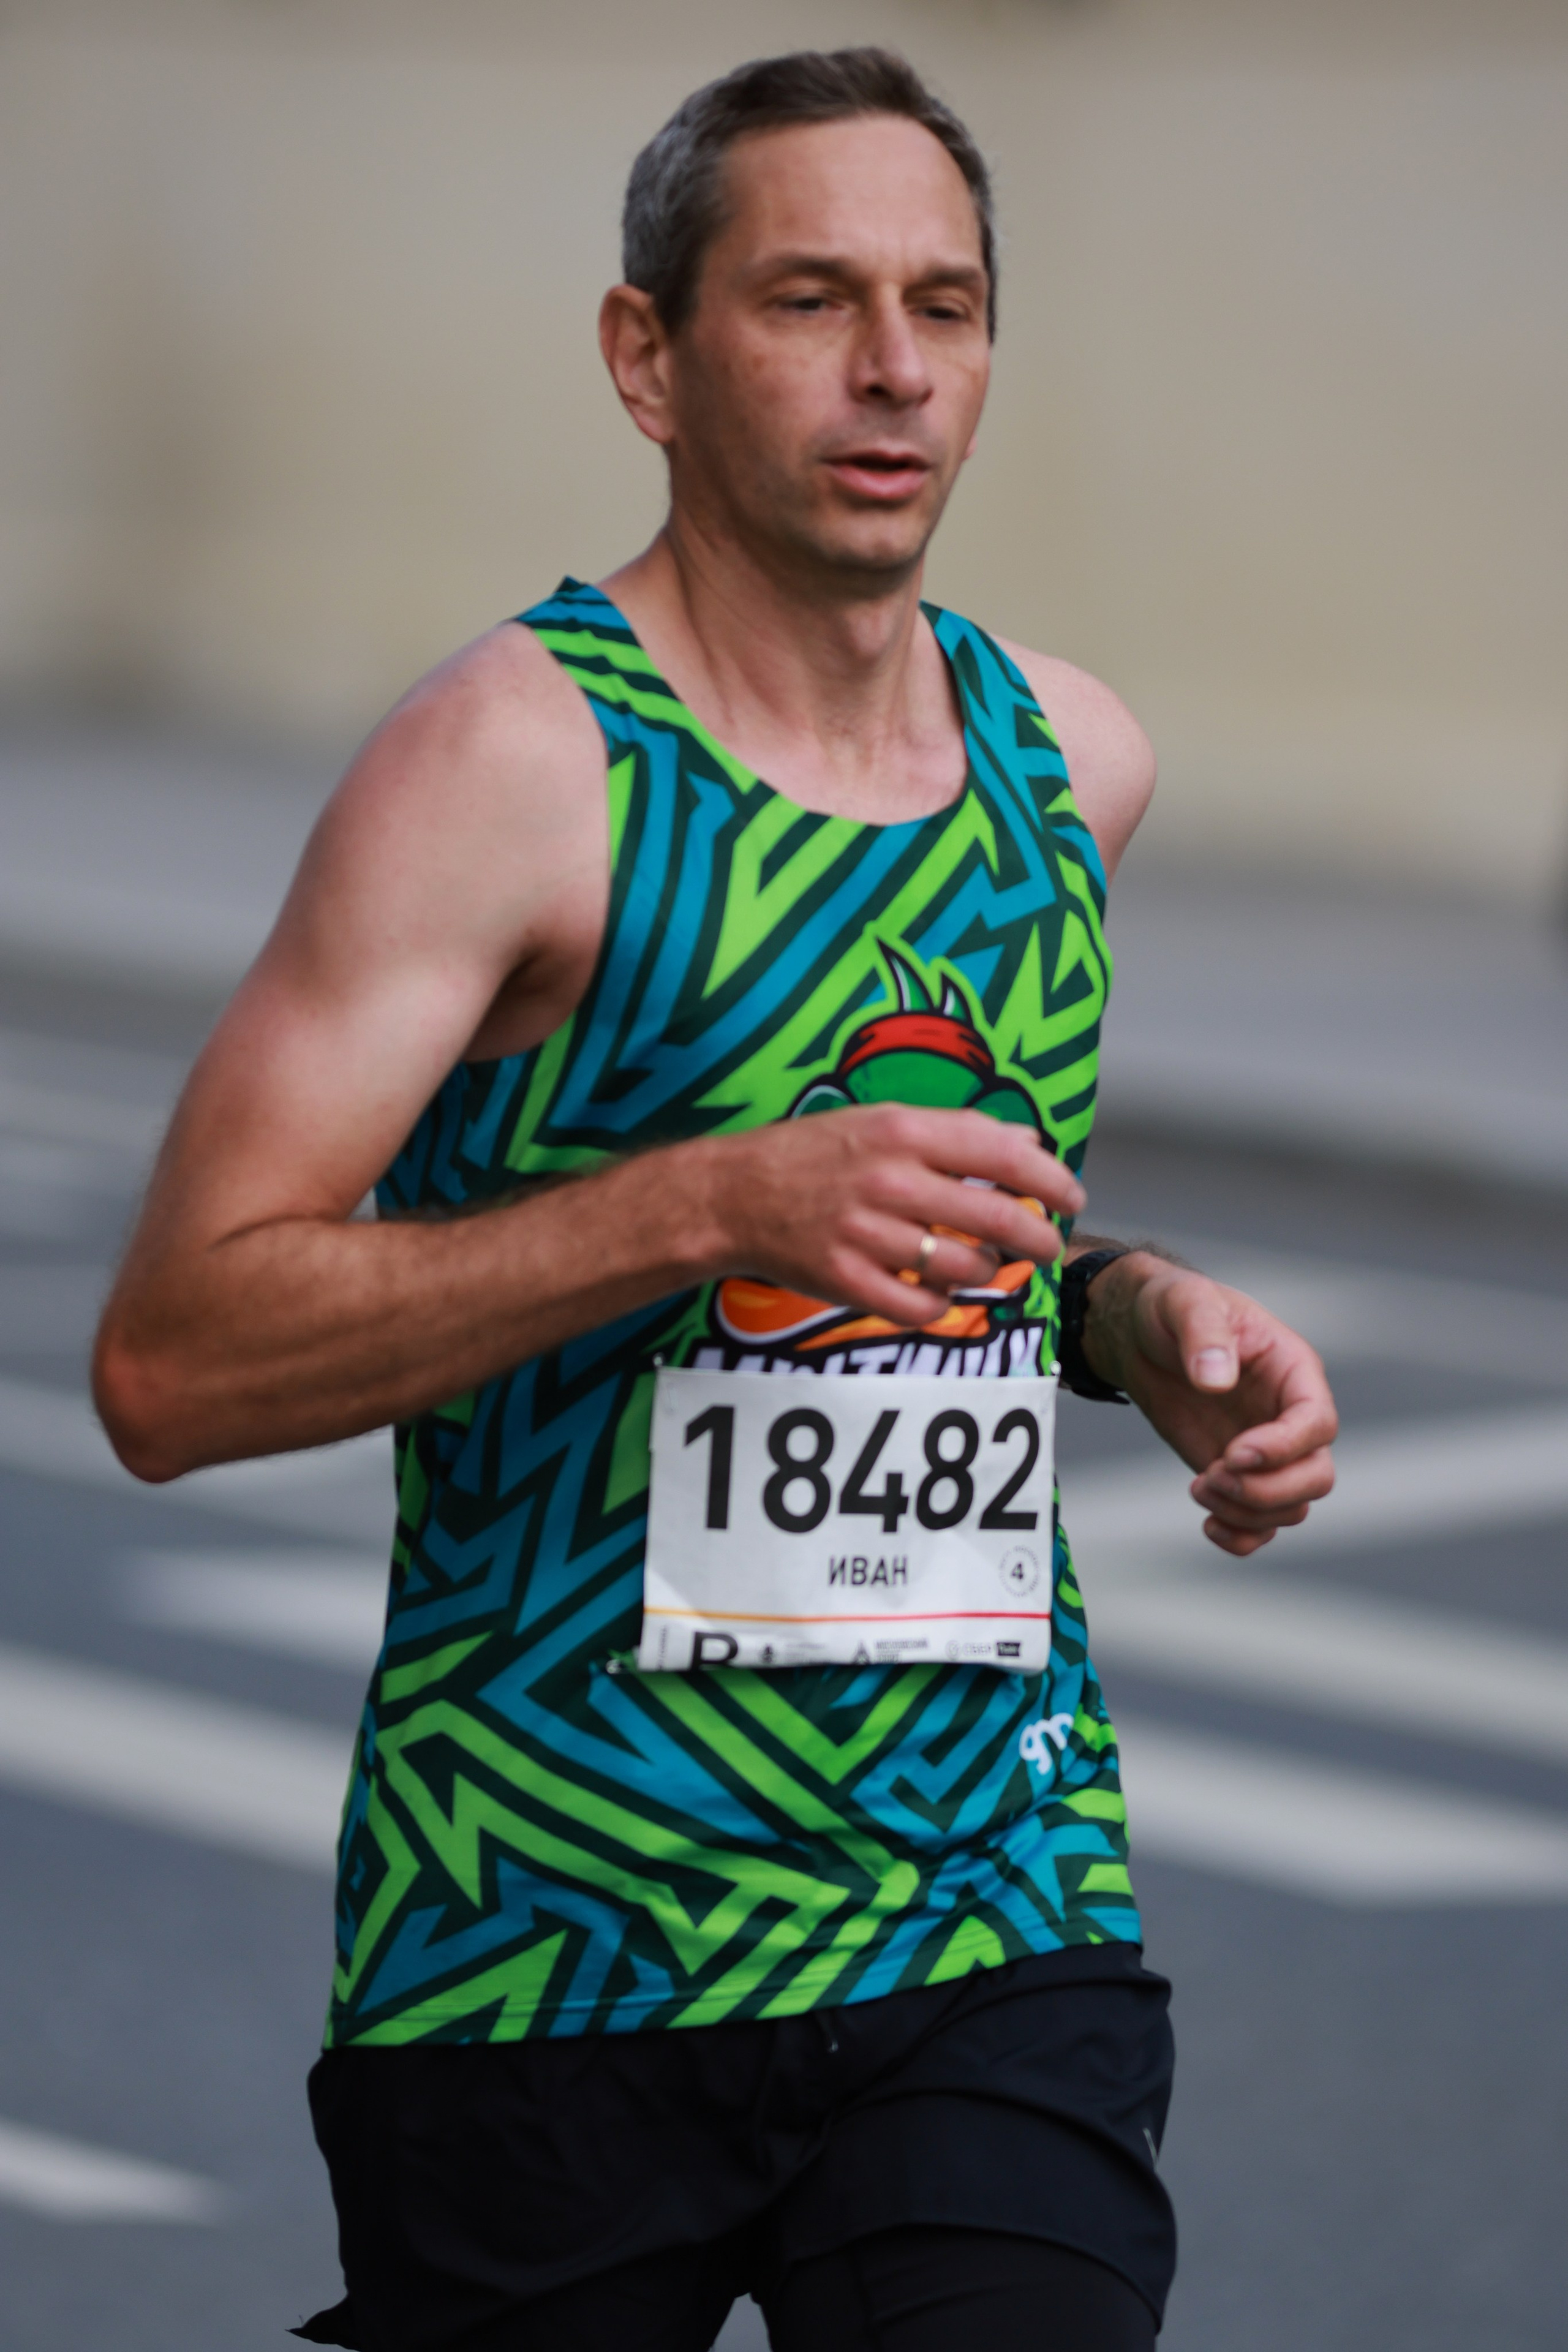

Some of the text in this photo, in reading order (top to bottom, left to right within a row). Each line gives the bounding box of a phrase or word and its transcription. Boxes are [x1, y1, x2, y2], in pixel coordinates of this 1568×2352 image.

[684, 1404, 1041, 1534] 18482
[829, 1555, 908, 1586] ИВАН
[1010, 1562, 1024, 1581] 4
